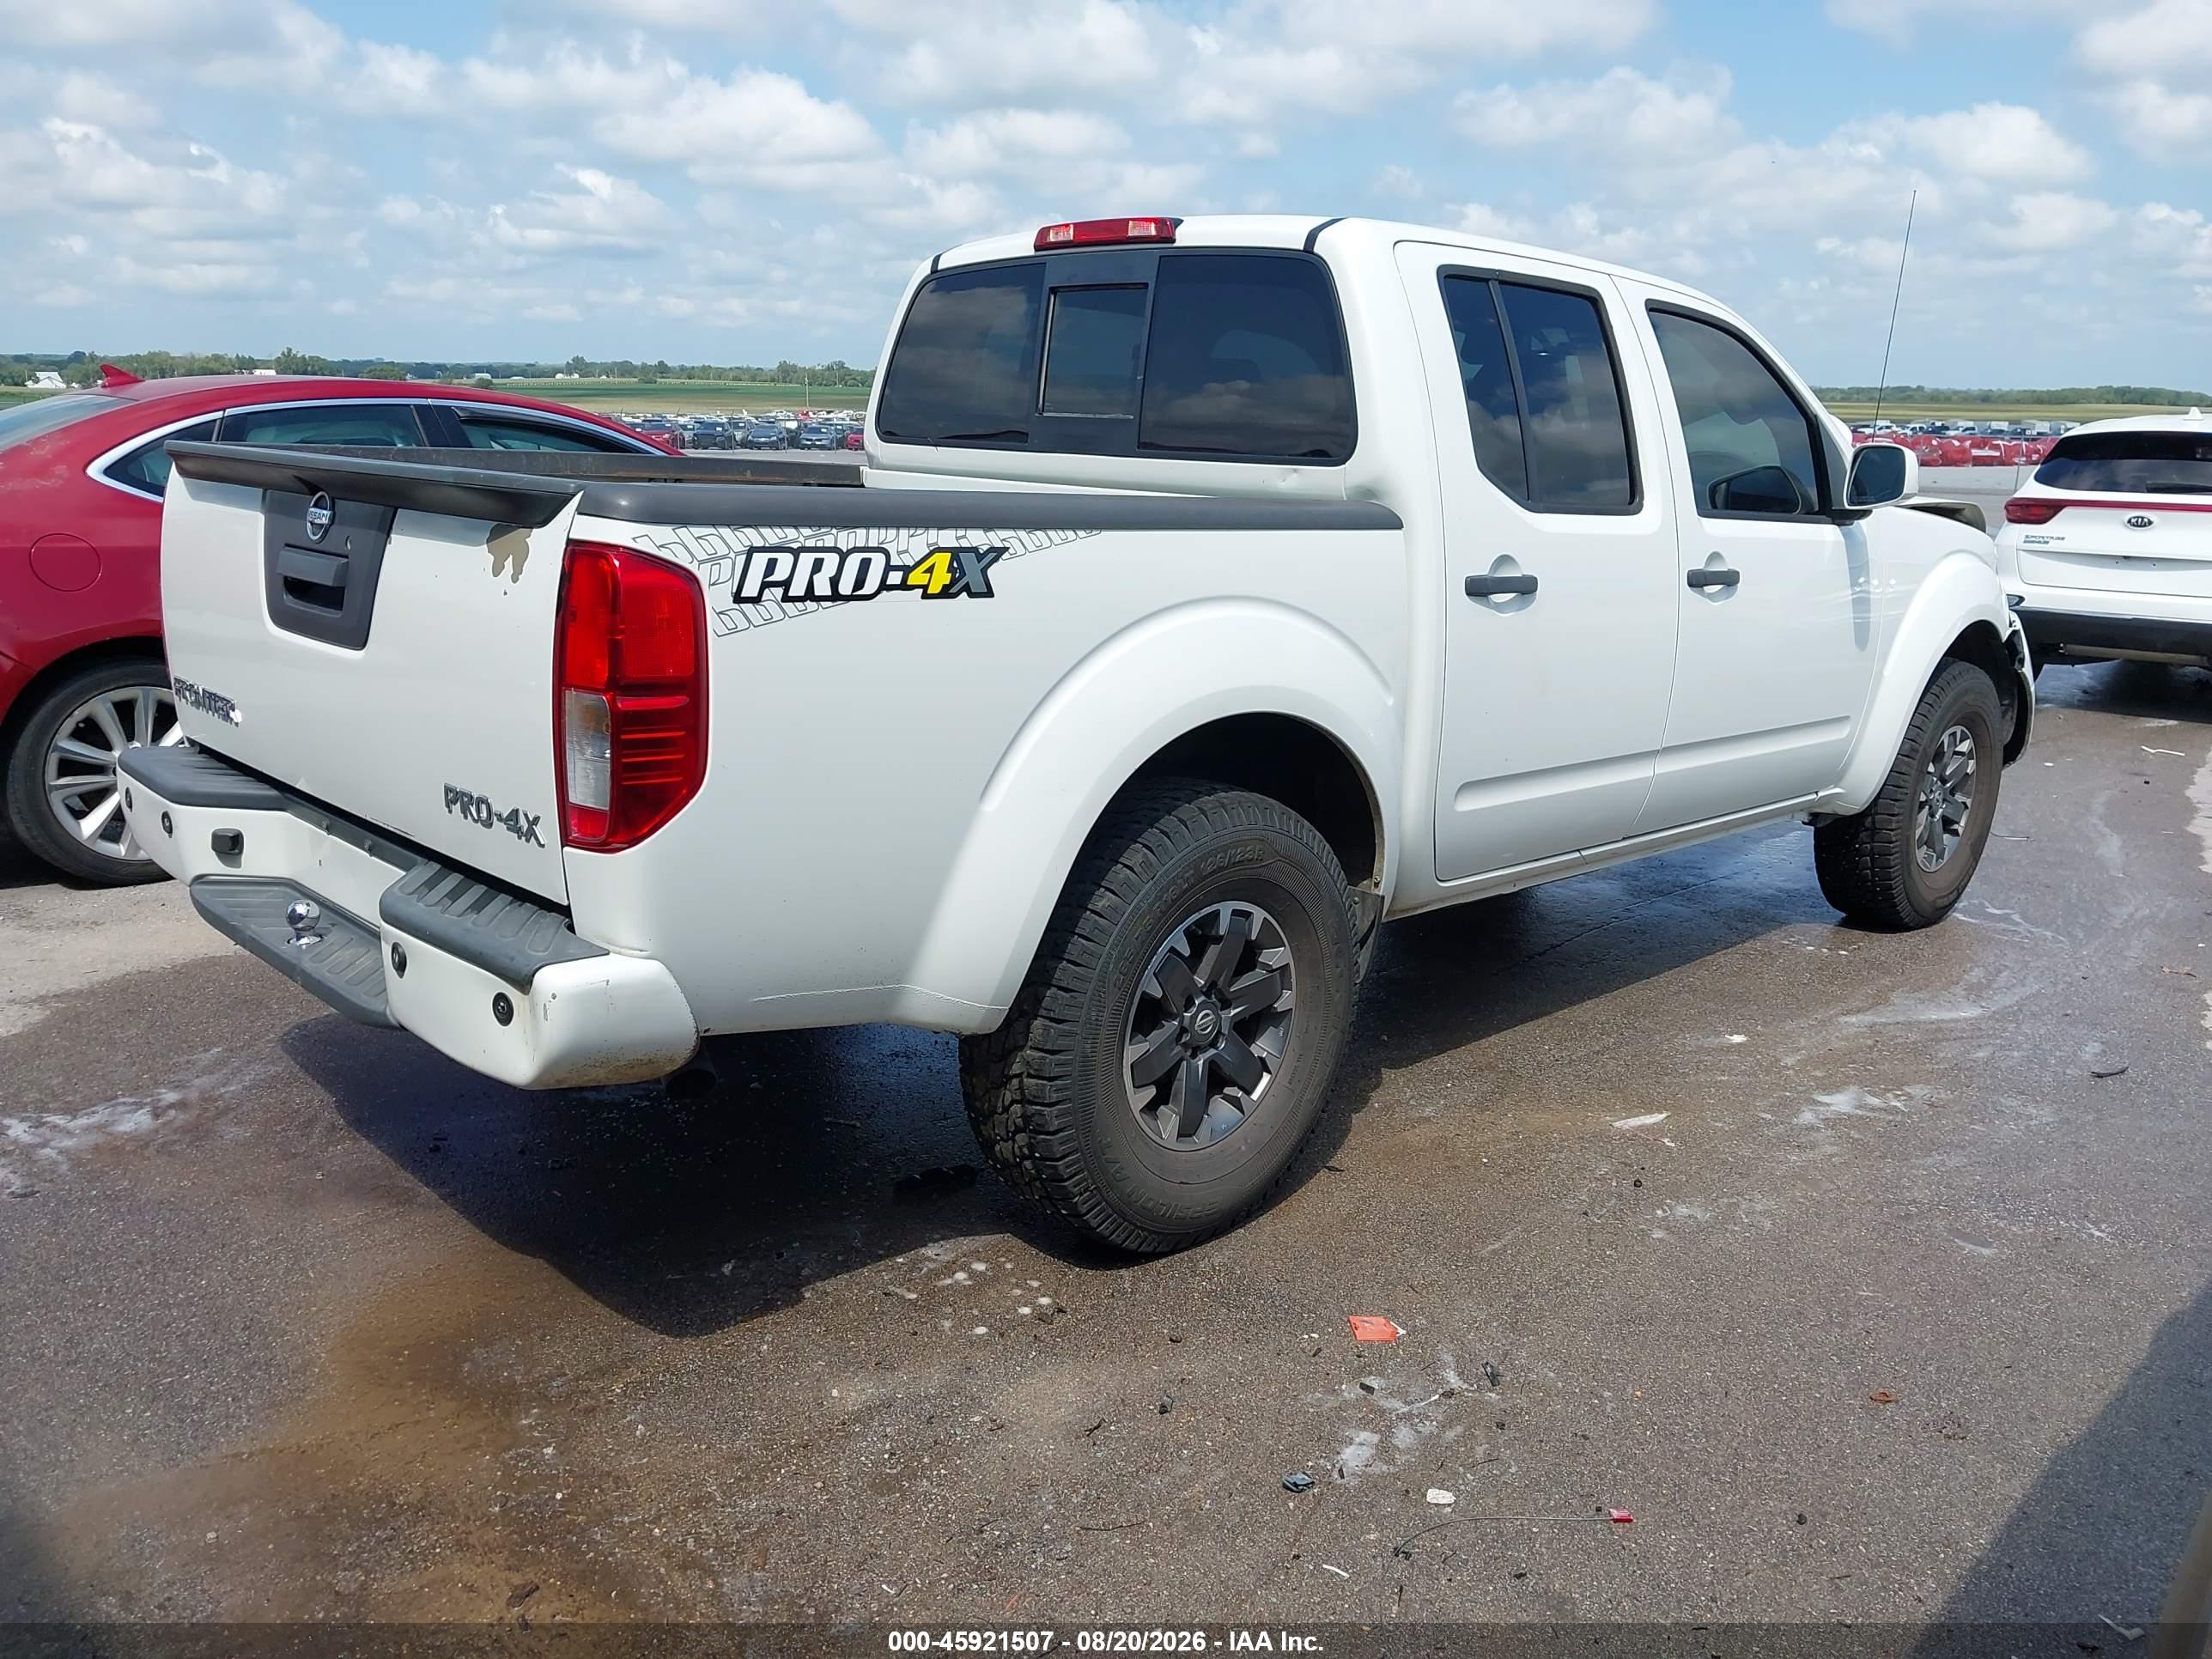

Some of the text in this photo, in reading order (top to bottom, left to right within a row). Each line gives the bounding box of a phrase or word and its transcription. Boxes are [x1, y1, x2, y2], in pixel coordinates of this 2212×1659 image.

[2130, 517, 2152, 526] KIA
[733, 546, 1011, 604] PRO-4X
[443, 782, 546, 848] PRO-4X
